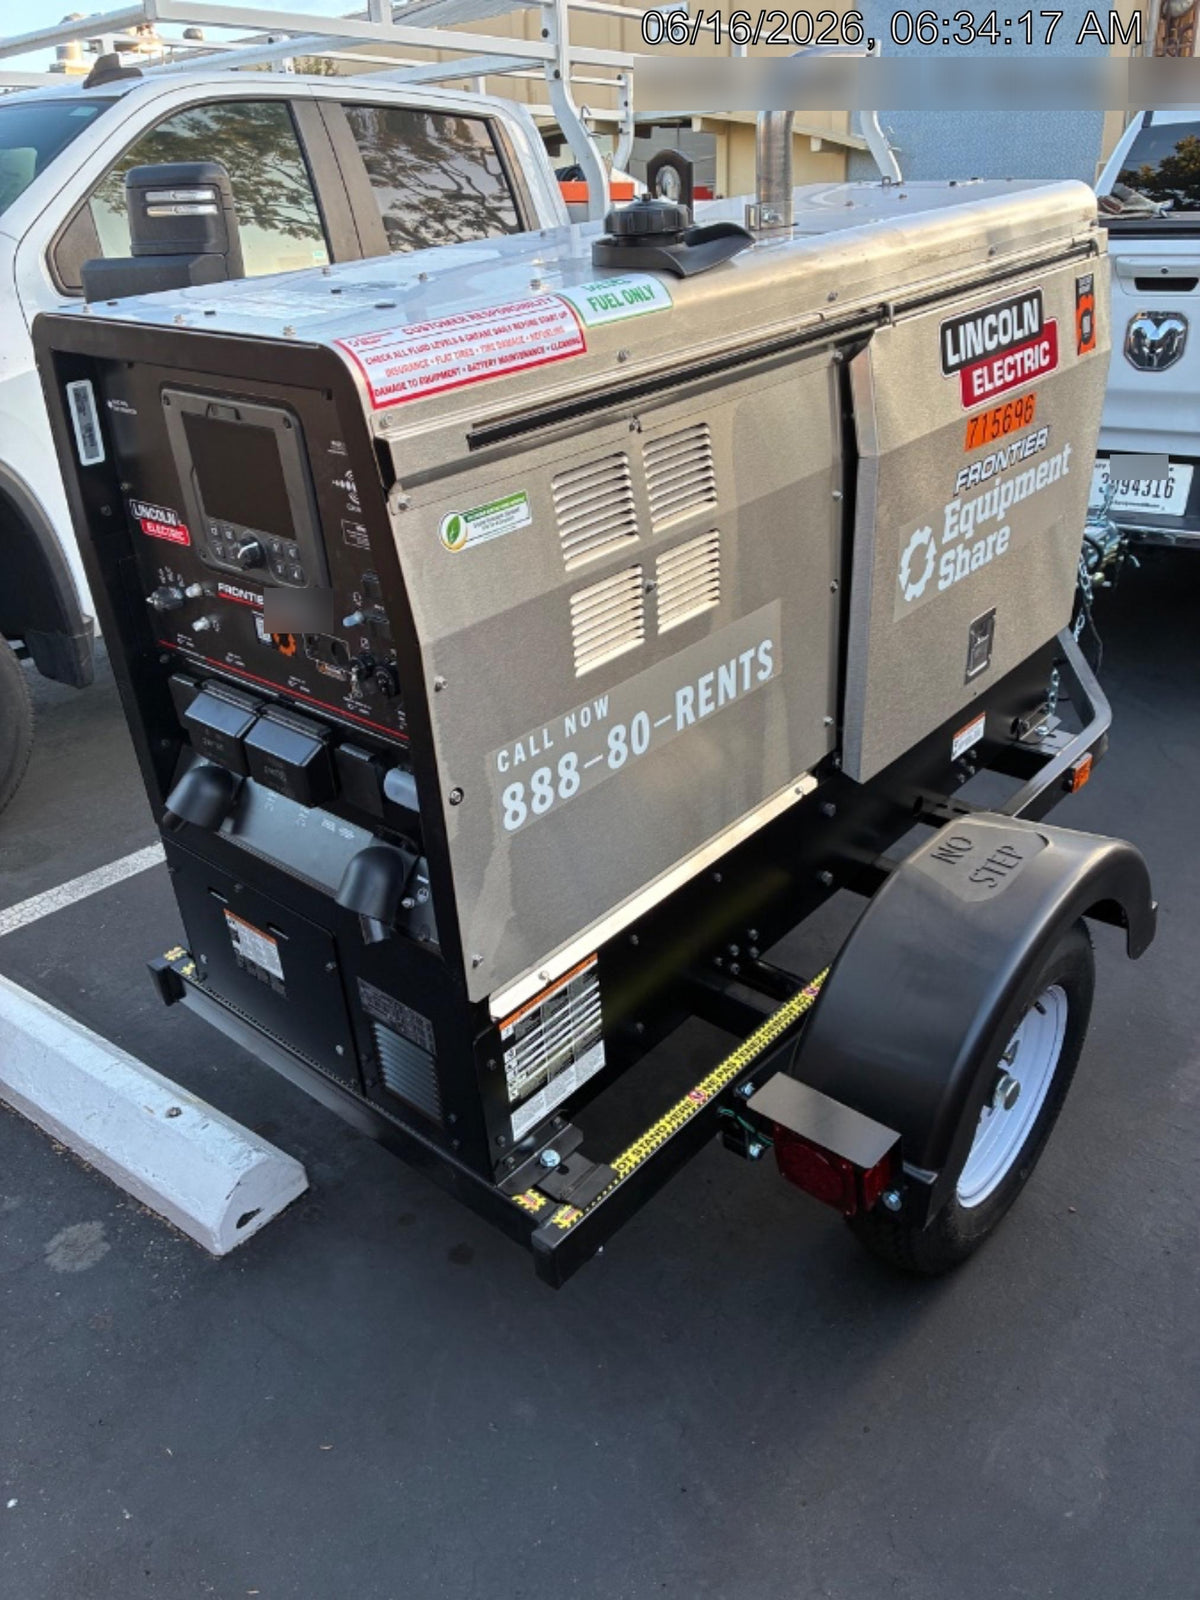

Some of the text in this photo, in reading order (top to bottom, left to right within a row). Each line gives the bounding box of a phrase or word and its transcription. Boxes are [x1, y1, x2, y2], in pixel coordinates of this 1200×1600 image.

[586, 292, 625, 312] FUEL
[621, 284, 656, 305] ONLY
[945, 298, 1040, 367] LINCOLN
[374, 382, 407, 397] DAMAGE
[407, 378, 418, 389] TO
[420, 367, 460, 385] EQUIPMENT
[467, 357, 497, 373] BATTERY
[972, 341, 1050, 397] ELECTRIC
[967, 395, 1035, 448] 715696
[953, 425, 1050, 496] FRONTIER
[133, 504, 176, 525] LINCOLN
[942, 442, 1072, 544] Equipment
[146, 522, 186, 542] ELECTRIC
[938, 525, 1010, 591] Share
[218, 582, 264, 604] FRONTIE
[497, 694, 610, 772] CALL NOW
[502, 639, 774, 831] 888-80-RENTS
[930, 836, 974, 865] NO
[969, 845, 1024, 888] STEP
[630, 1123, 668, 1158] STAND
